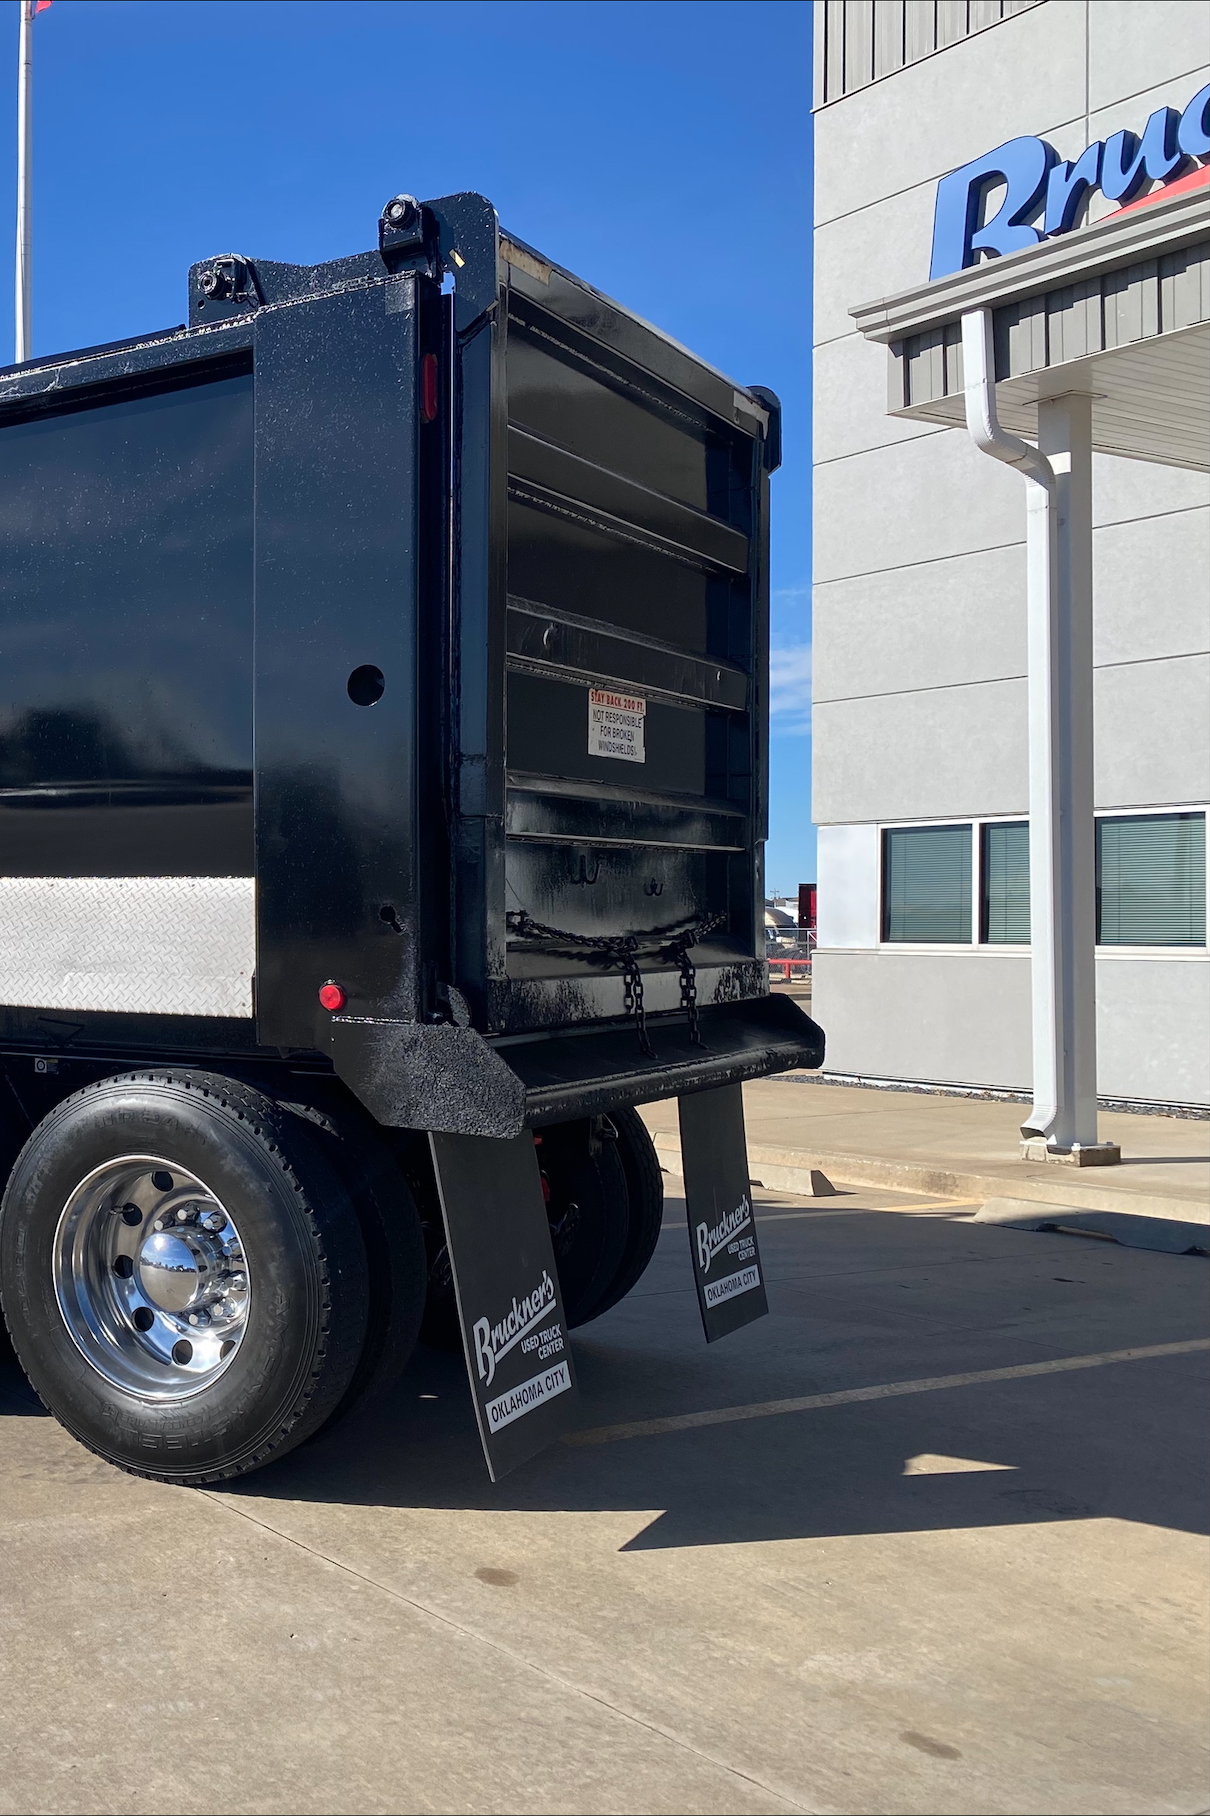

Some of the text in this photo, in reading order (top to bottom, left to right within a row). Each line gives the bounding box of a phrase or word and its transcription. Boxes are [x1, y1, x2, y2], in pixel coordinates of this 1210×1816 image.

[591, 690, 605, 704] STAY
[606, 694, 622, 707] BACK
[623, 699, 635, 710] 200
[593, 708, 642, 729] NOT RESPONSIBLE
[600, 725, 635, 741] FOR BROKEN
[696, 1194, 750, 1274] Bruckner's
[707, 1269, 757, 1302] OKLAHOMA CITY
[472, 1269, 556, 1387] Bruckner's
[521, 1324, 561, 1354] USED TRUCK
[537, 1337, 564, 1360] CENTER
[491, 1367, 565, 1423] OKLAHOMA CITY
